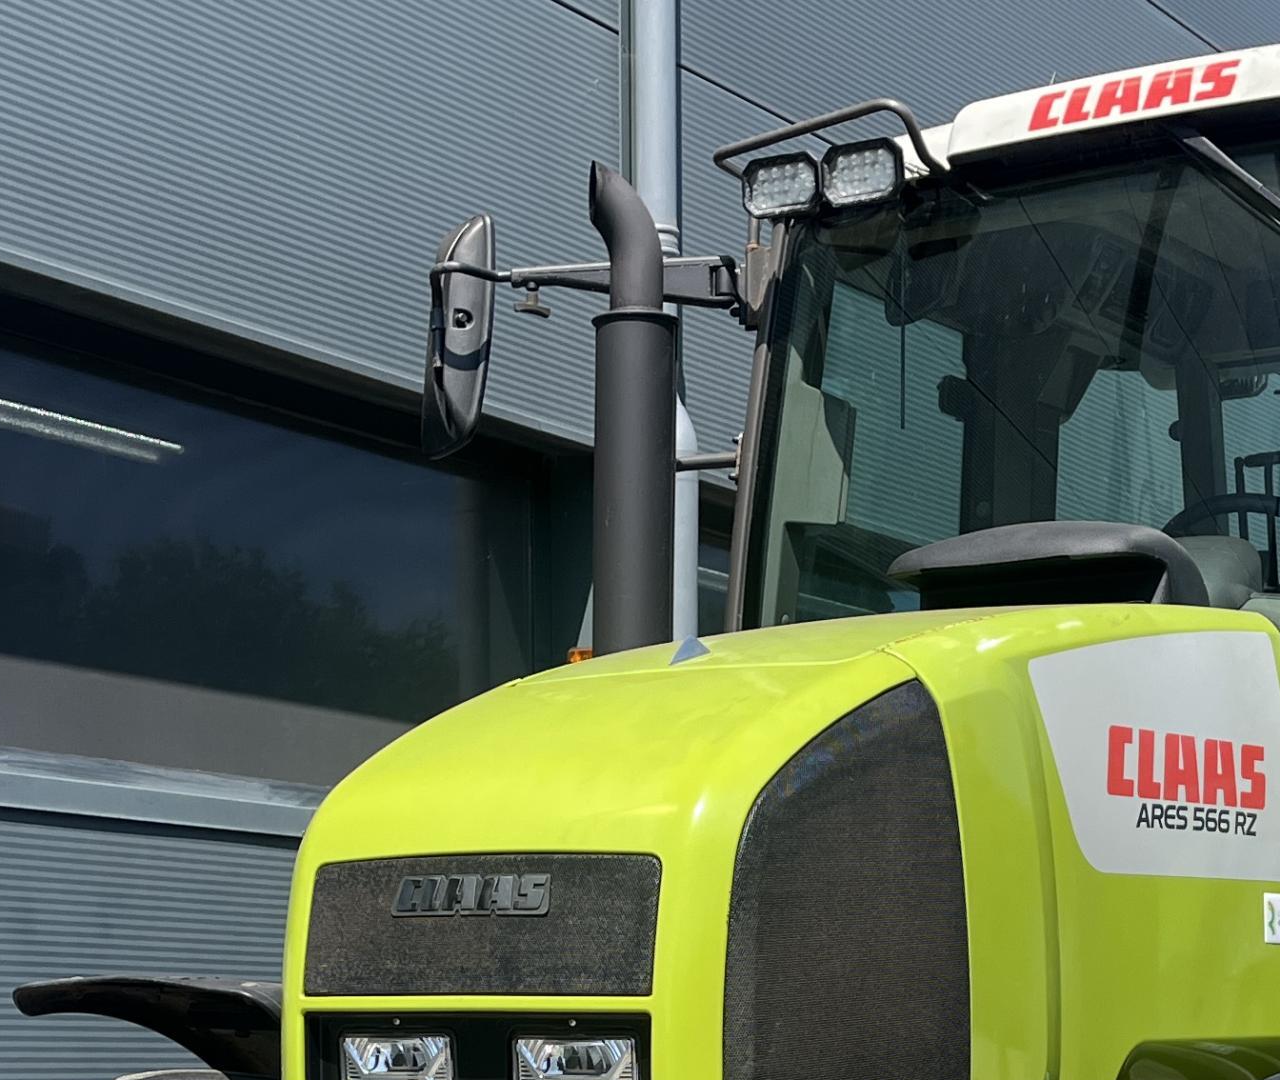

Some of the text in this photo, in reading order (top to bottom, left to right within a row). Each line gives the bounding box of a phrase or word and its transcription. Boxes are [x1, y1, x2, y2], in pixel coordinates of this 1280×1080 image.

[1028, 59, 1241, 131] CLAAS
[1107, 724, 1266, 810] CLAAS
[1136, 803, 1258, 836] ARES 566 RZ
[394, 874, 551, 915] CLAAS
